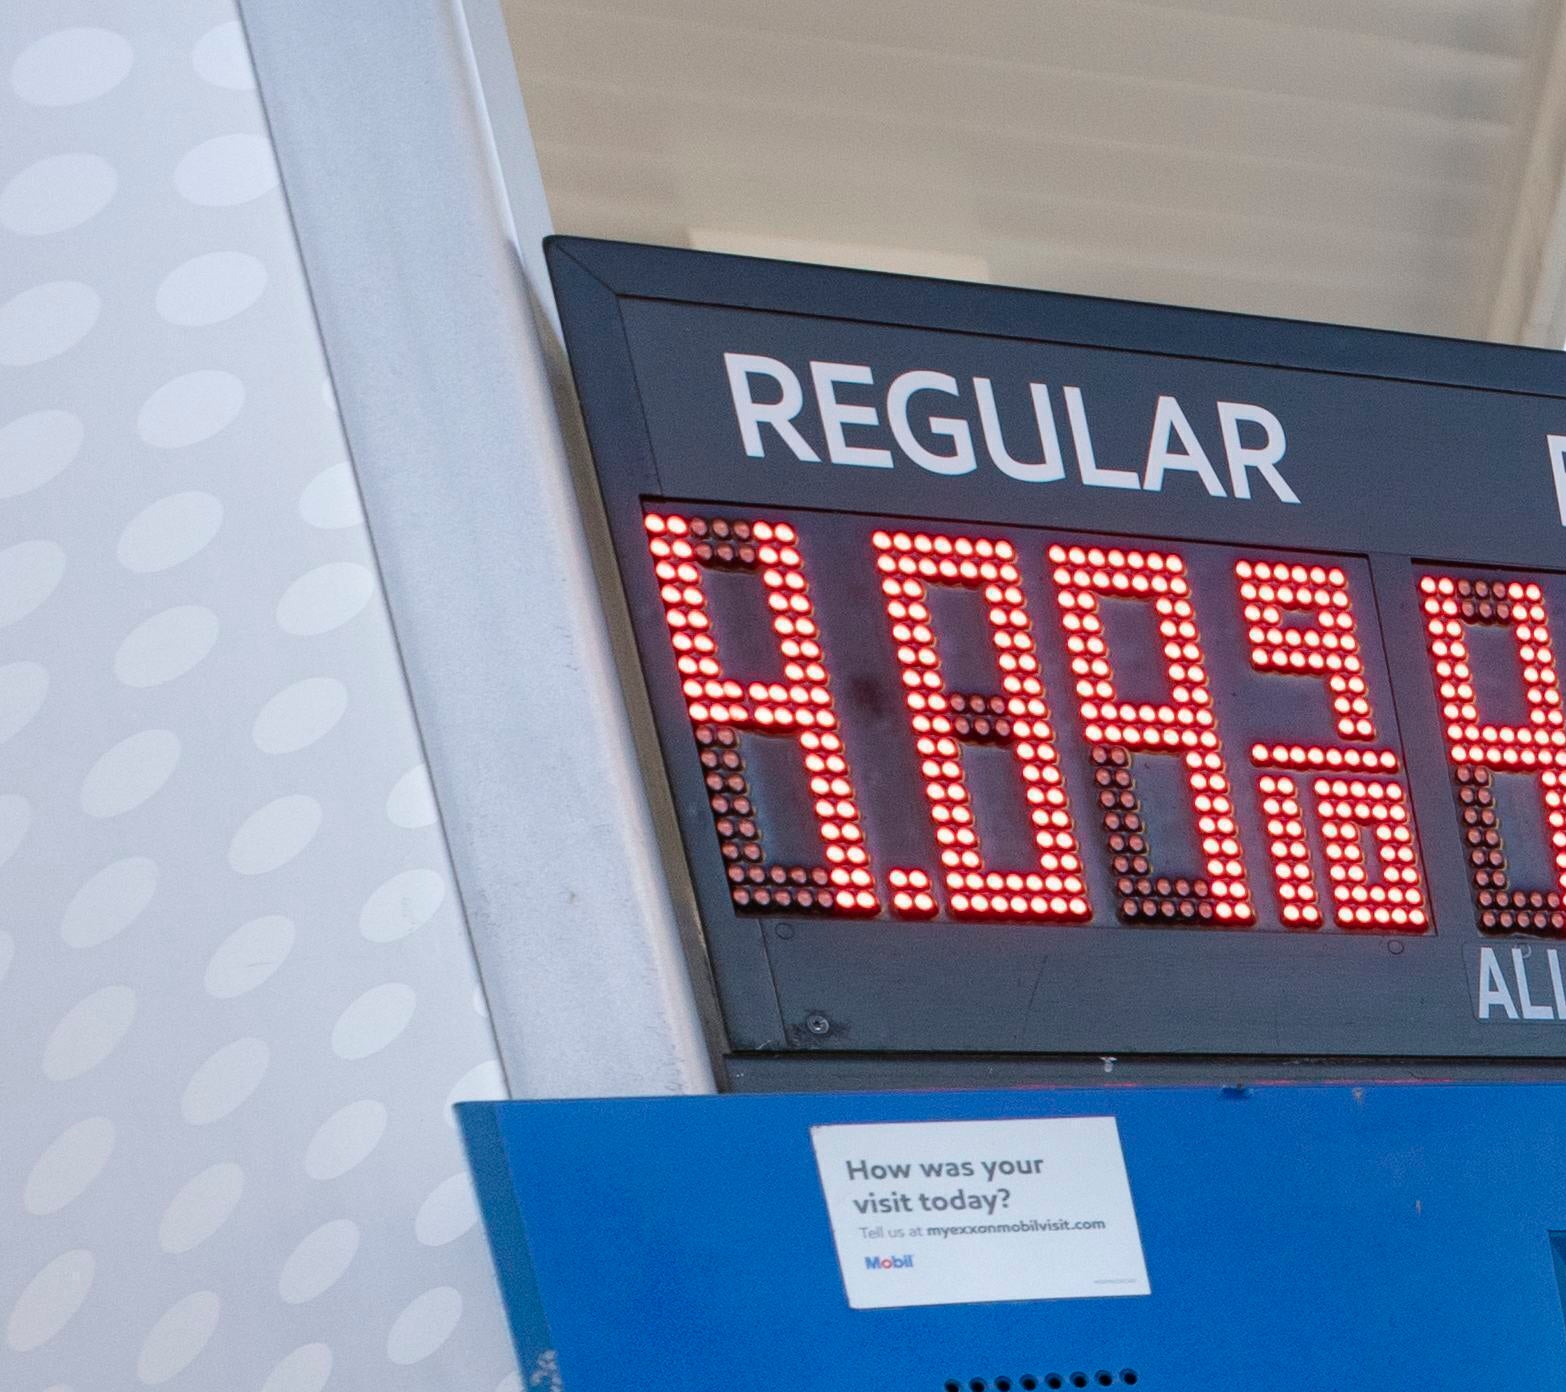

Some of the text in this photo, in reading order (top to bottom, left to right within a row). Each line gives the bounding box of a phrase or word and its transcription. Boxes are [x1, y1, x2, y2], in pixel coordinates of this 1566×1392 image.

[723, 352, 1301, 505] REGULAR
[847, 1156, 1044, 1181] How was your
[854, 1189, 1011, 1215] visit today?
[860, 1218, 1106, 1241] Tell us at myexxonmobilvisit.com
[865, 1254, 914, 1271] Mobil
